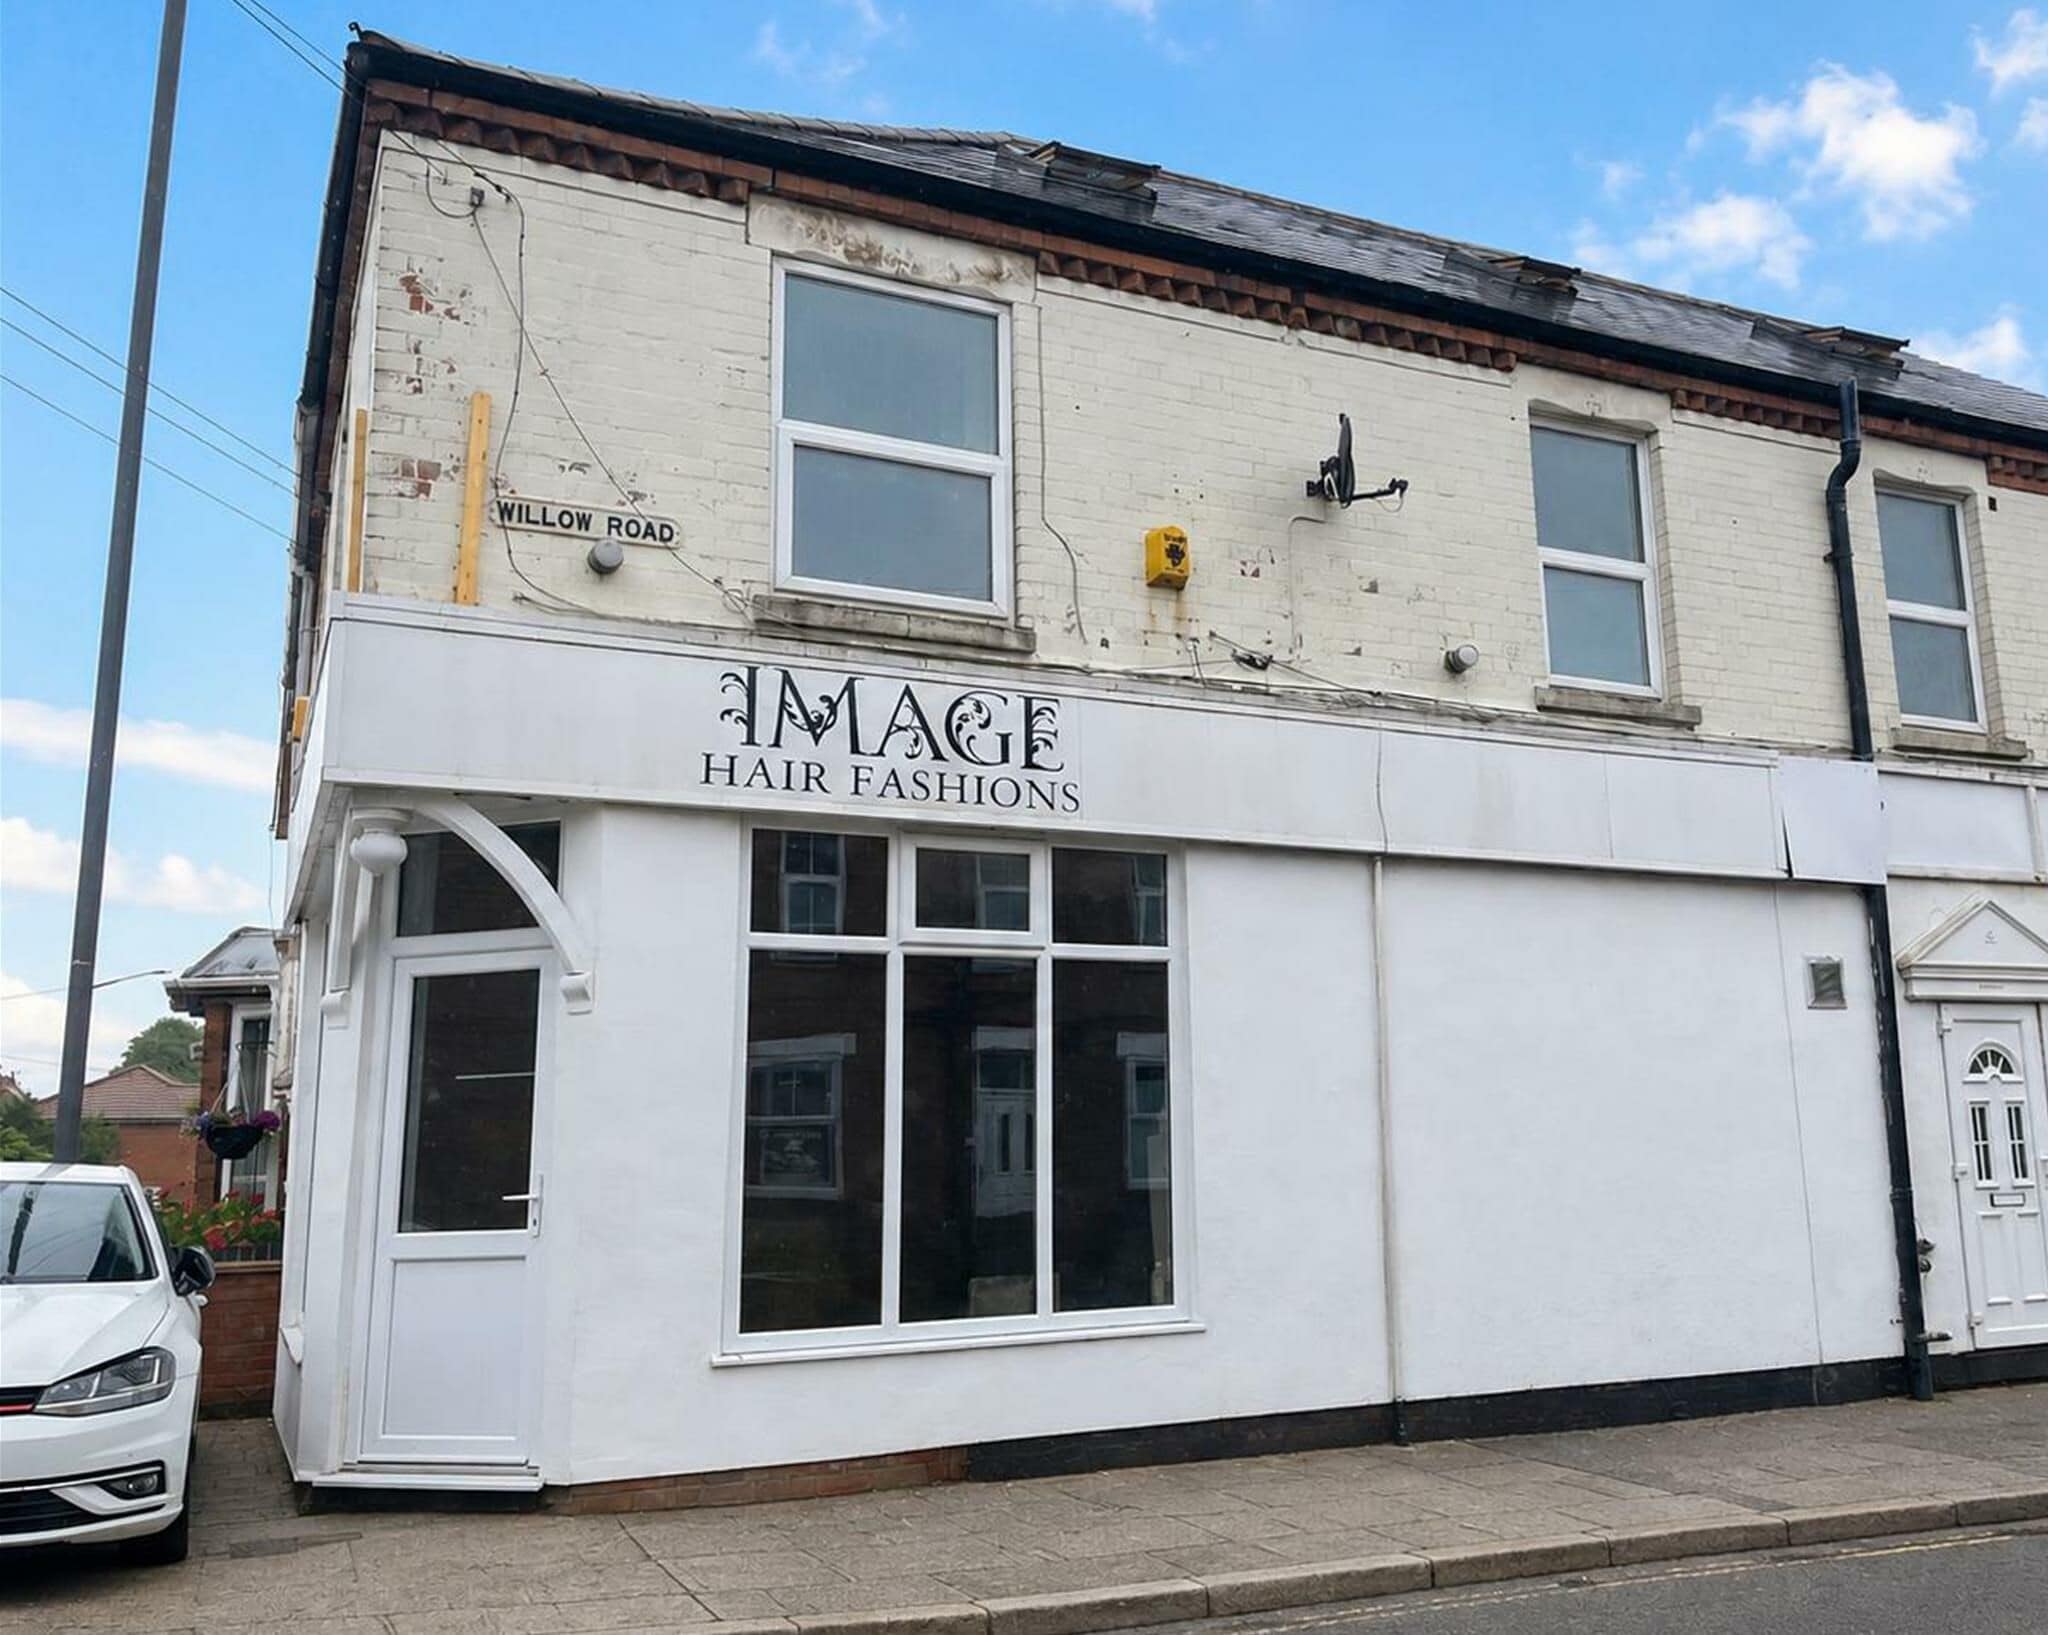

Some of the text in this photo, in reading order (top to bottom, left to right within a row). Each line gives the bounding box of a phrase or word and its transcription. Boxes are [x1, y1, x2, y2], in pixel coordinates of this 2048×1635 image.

[497, 500, 674, 542] WILLOW ROAD
[720, 665, 1064, 772] IMAGE
[700, 752, 1080, 813] HAIR FASHIONS
